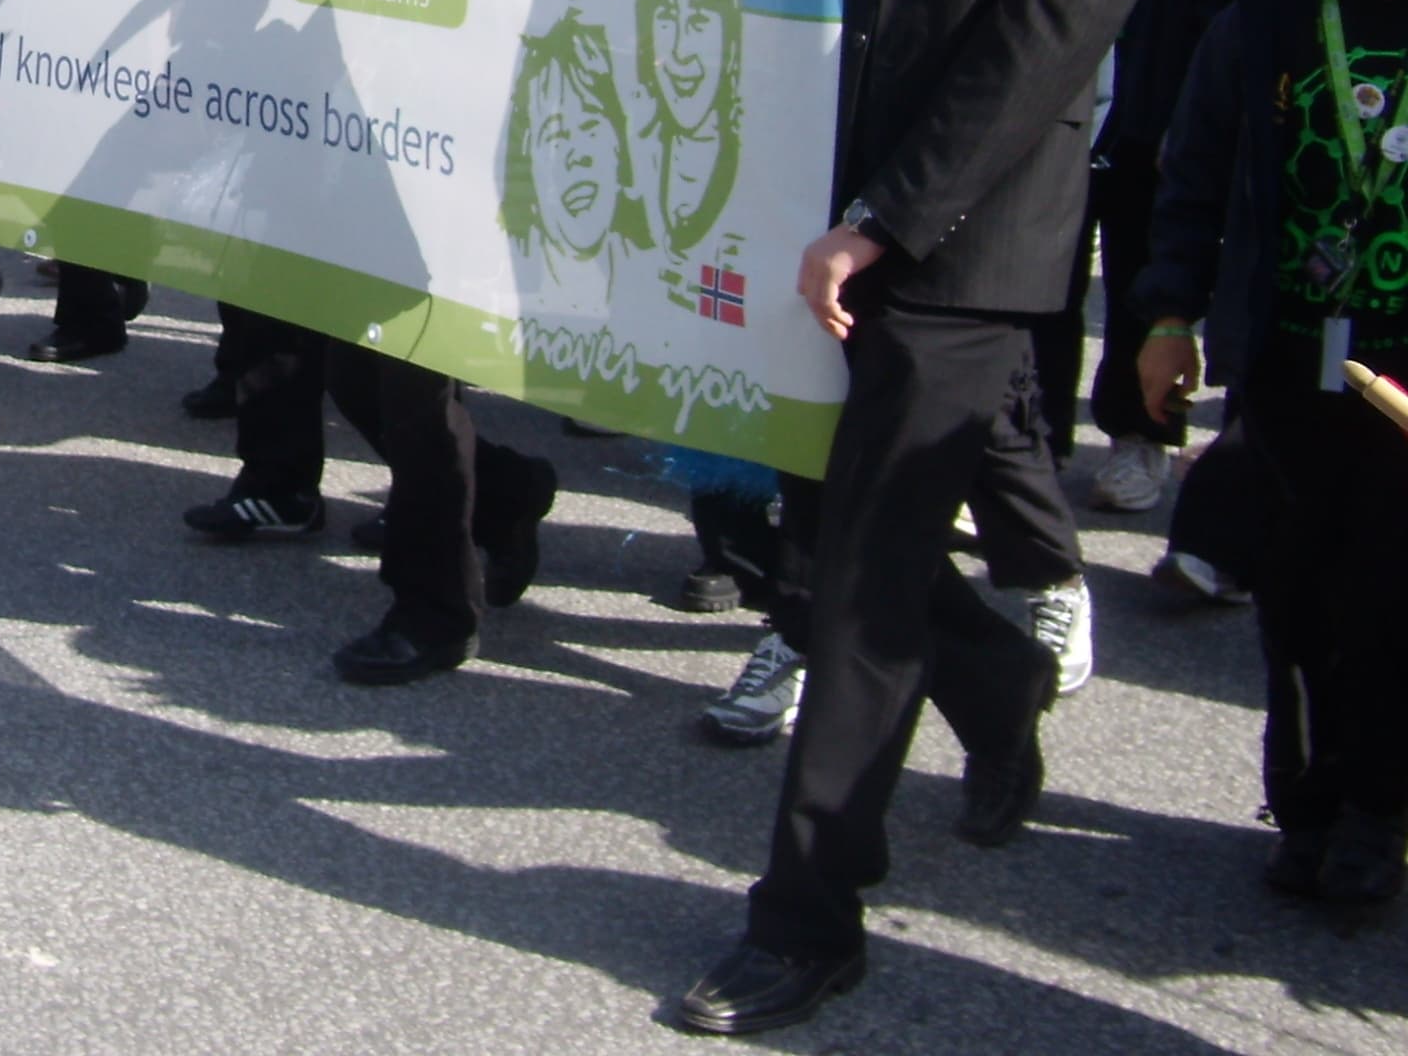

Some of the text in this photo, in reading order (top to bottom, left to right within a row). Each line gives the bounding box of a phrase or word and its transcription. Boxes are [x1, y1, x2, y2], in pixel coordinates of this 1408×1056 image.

[16, 36, 192, 117] knowlegde
[206, 82, 309, 140] across
[323, 92, 454, 176] borders
[509, 316, 640, 394] moves
[659, 364, 773, 435] you
